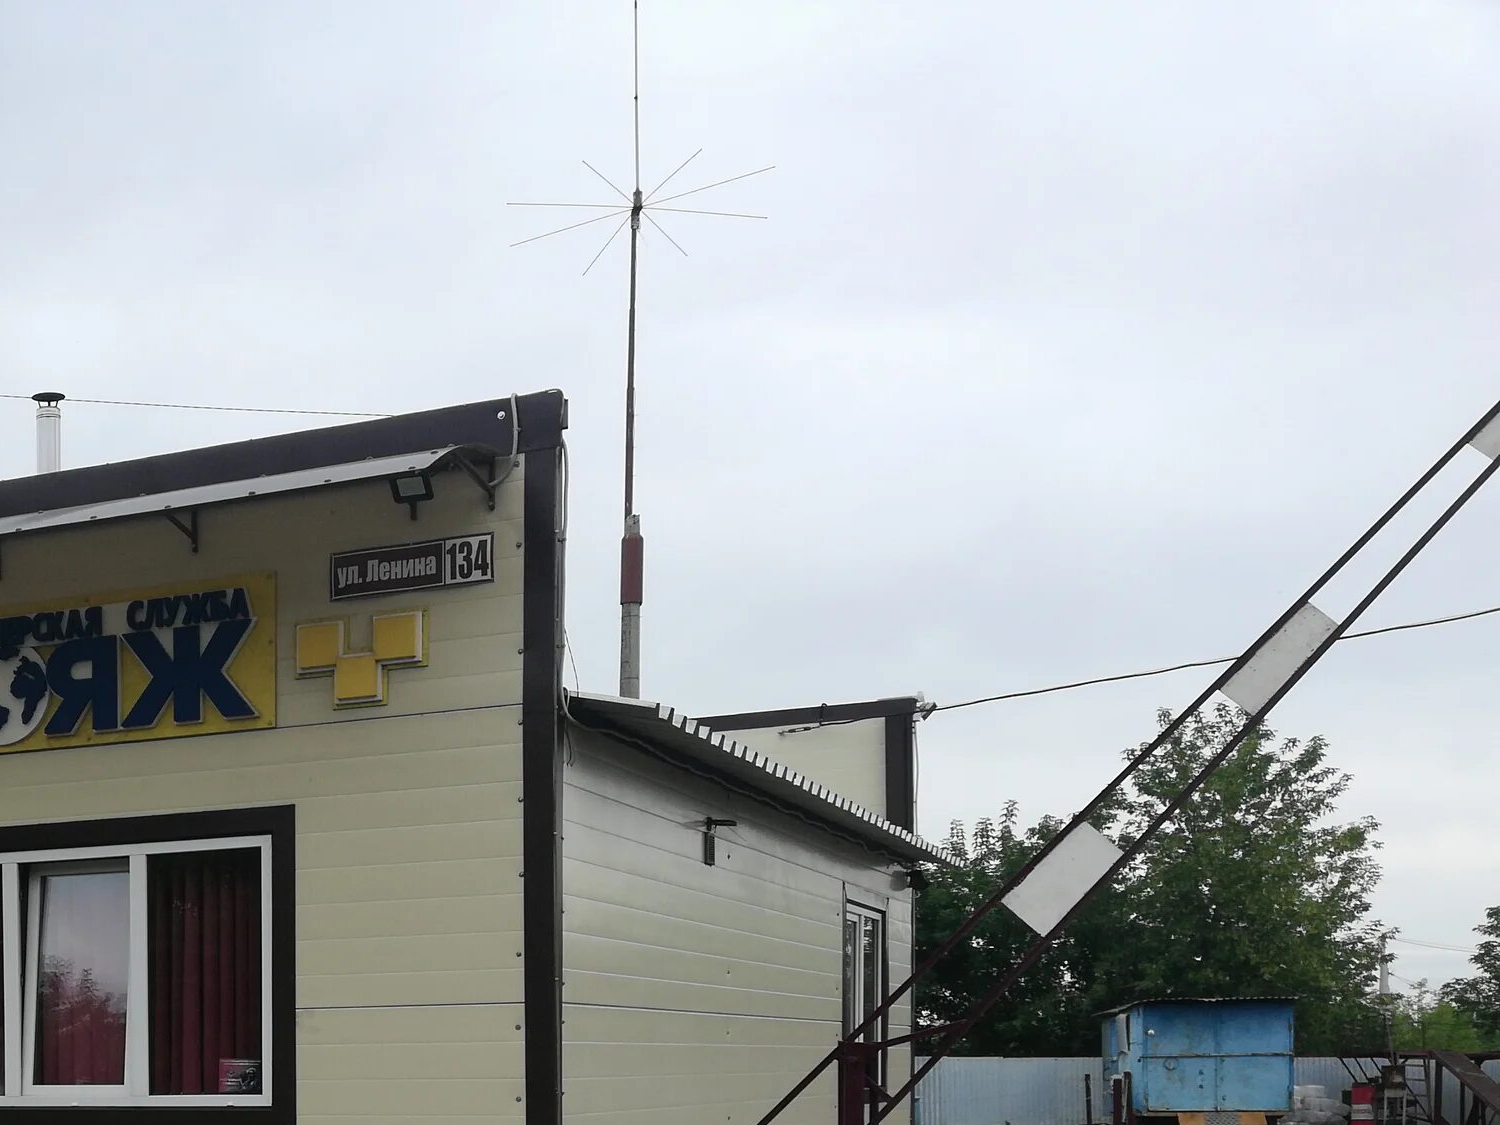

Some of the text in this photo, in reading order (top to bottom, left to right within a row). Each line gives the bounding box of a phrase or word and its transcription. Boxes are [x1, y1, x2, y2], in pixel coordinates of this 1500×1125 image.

[337, 540, 489, 588] ул. Ленина 134
[126, 588, 250, 630] СЛУЖБА
